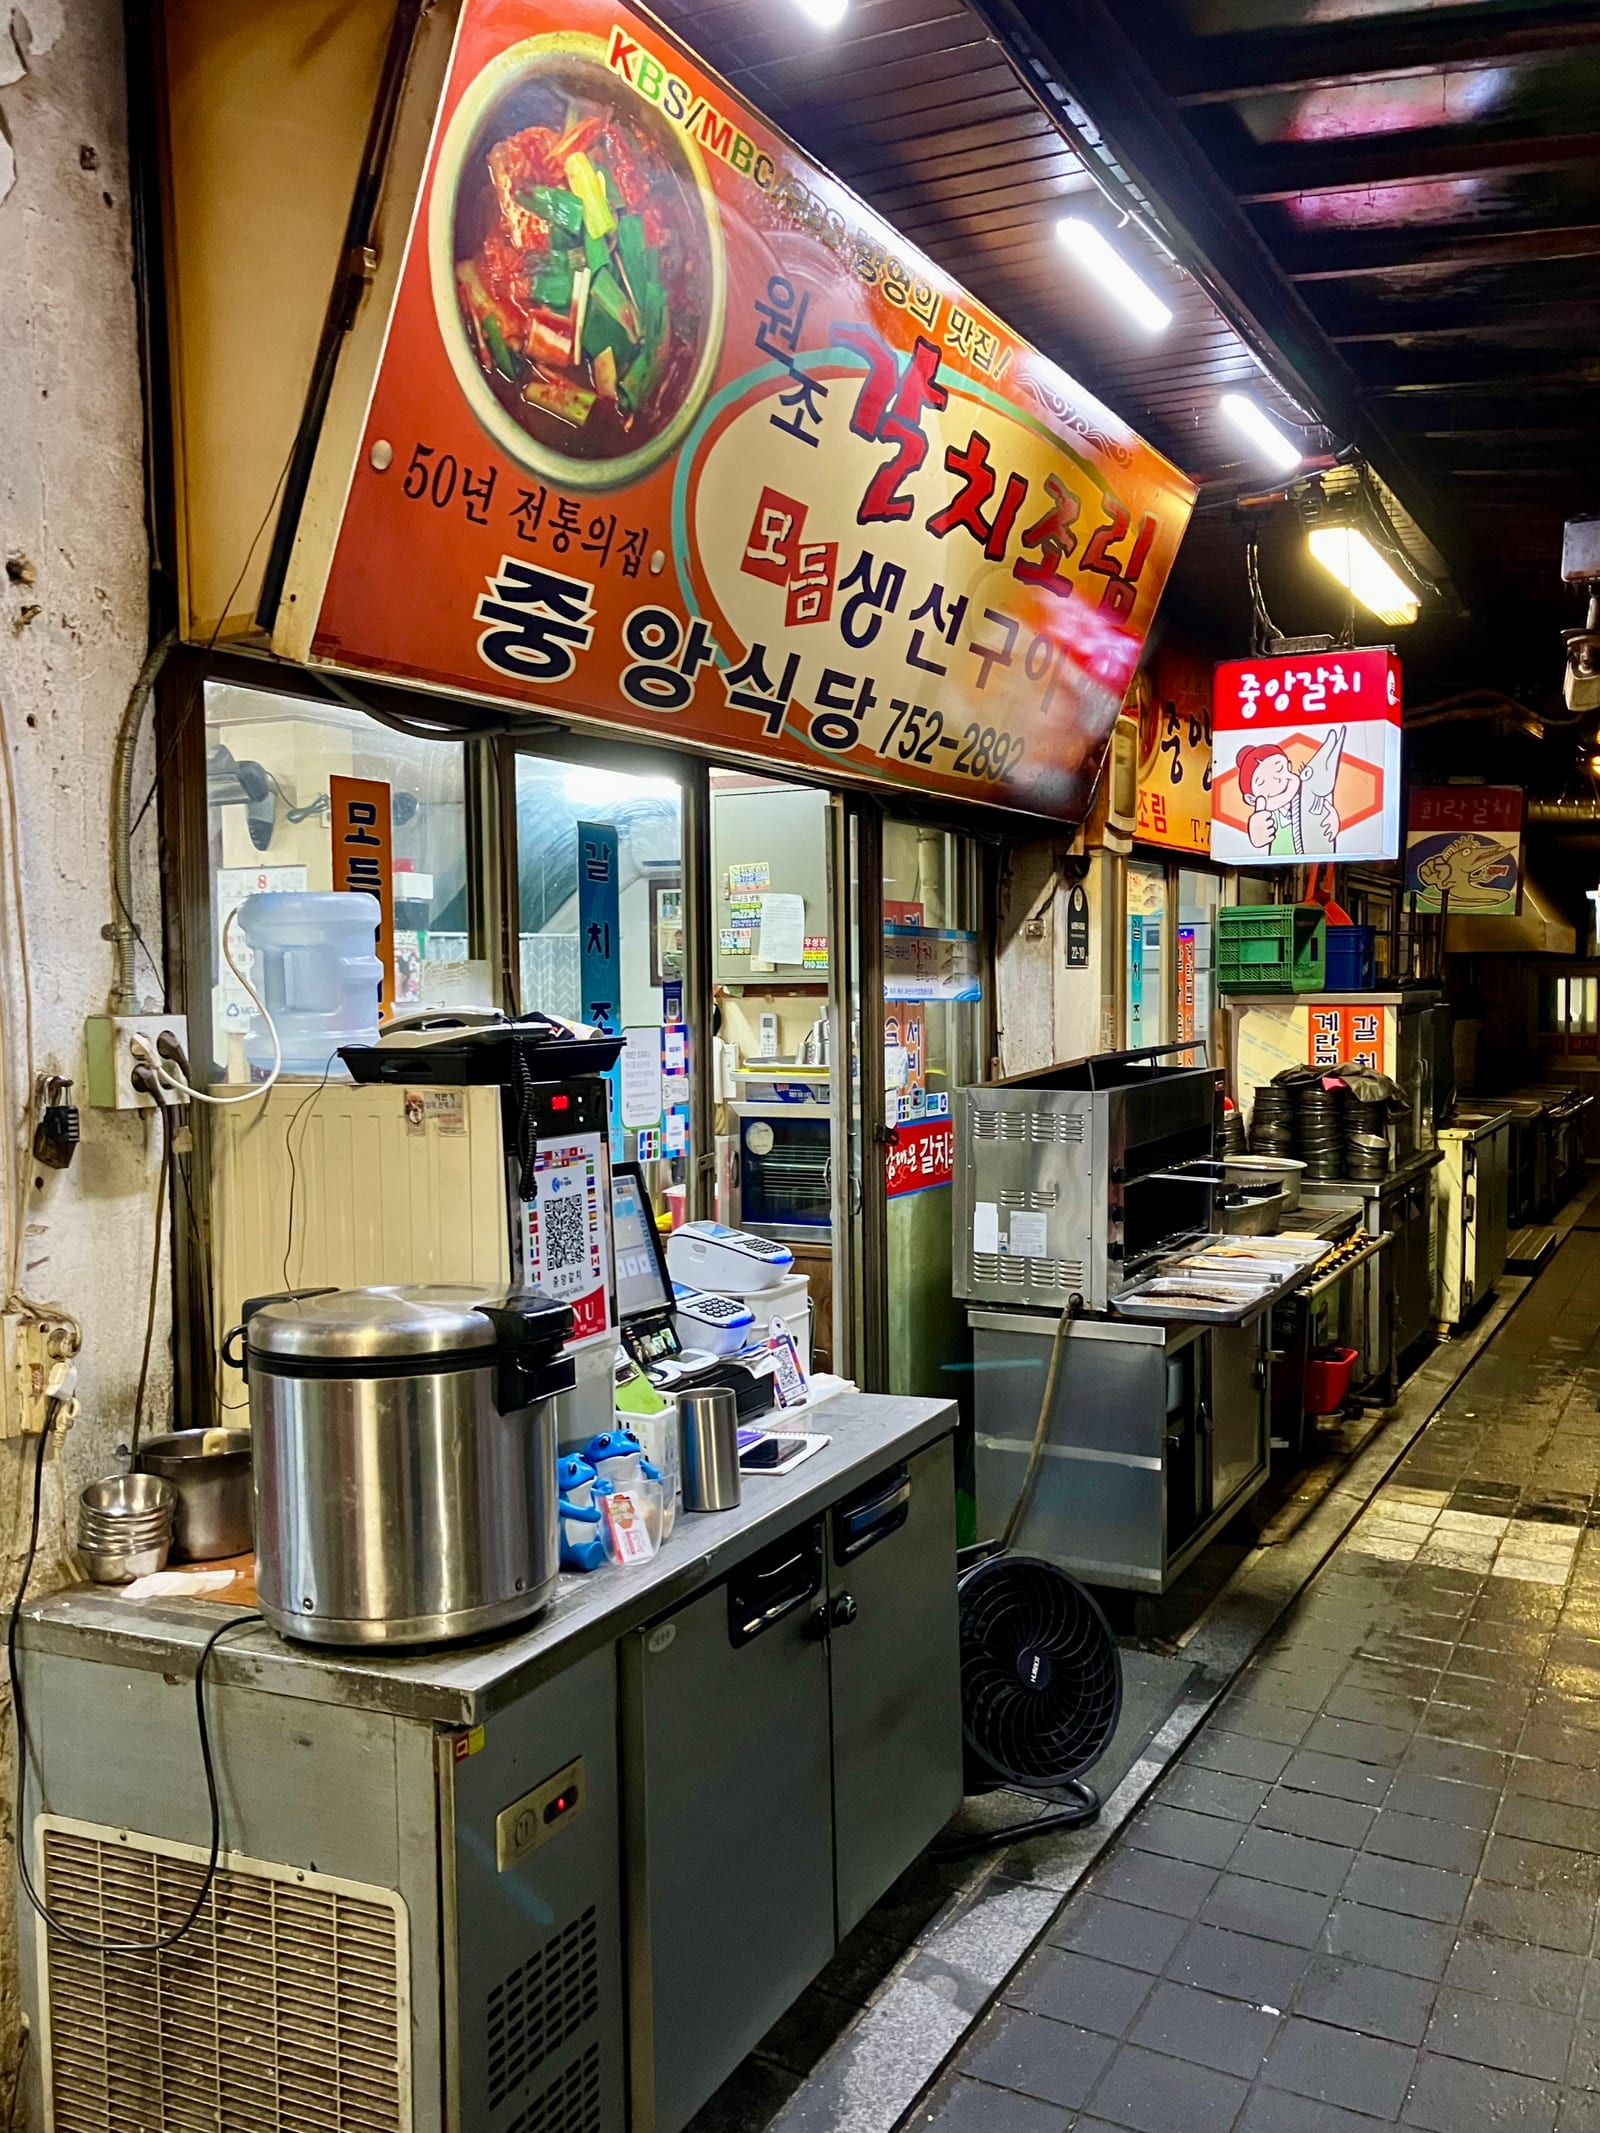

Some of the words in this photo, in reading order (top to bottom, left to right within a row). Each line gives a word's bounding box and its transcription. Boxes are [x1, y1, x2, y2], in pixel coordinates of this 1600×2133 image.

[754, 274, 829, 448] 원조
[948, 307, 1014, 379] 맛집!
[403, 443, 498, 526] 50년
[829, 319, 1157, 626] 갈치조림
[476, 558, 878, 750] 중앙식당
[879, 698, 1025, 785] 752-2892
[747, 508, 829, 620] 모듬
[839, 550, 1069, 714] 생선구이
[1238, 665, 1361, 719] 중앙갈치
[257, 875, 268, 889] 8
[586, 842, 614, 1113] 갈치조
